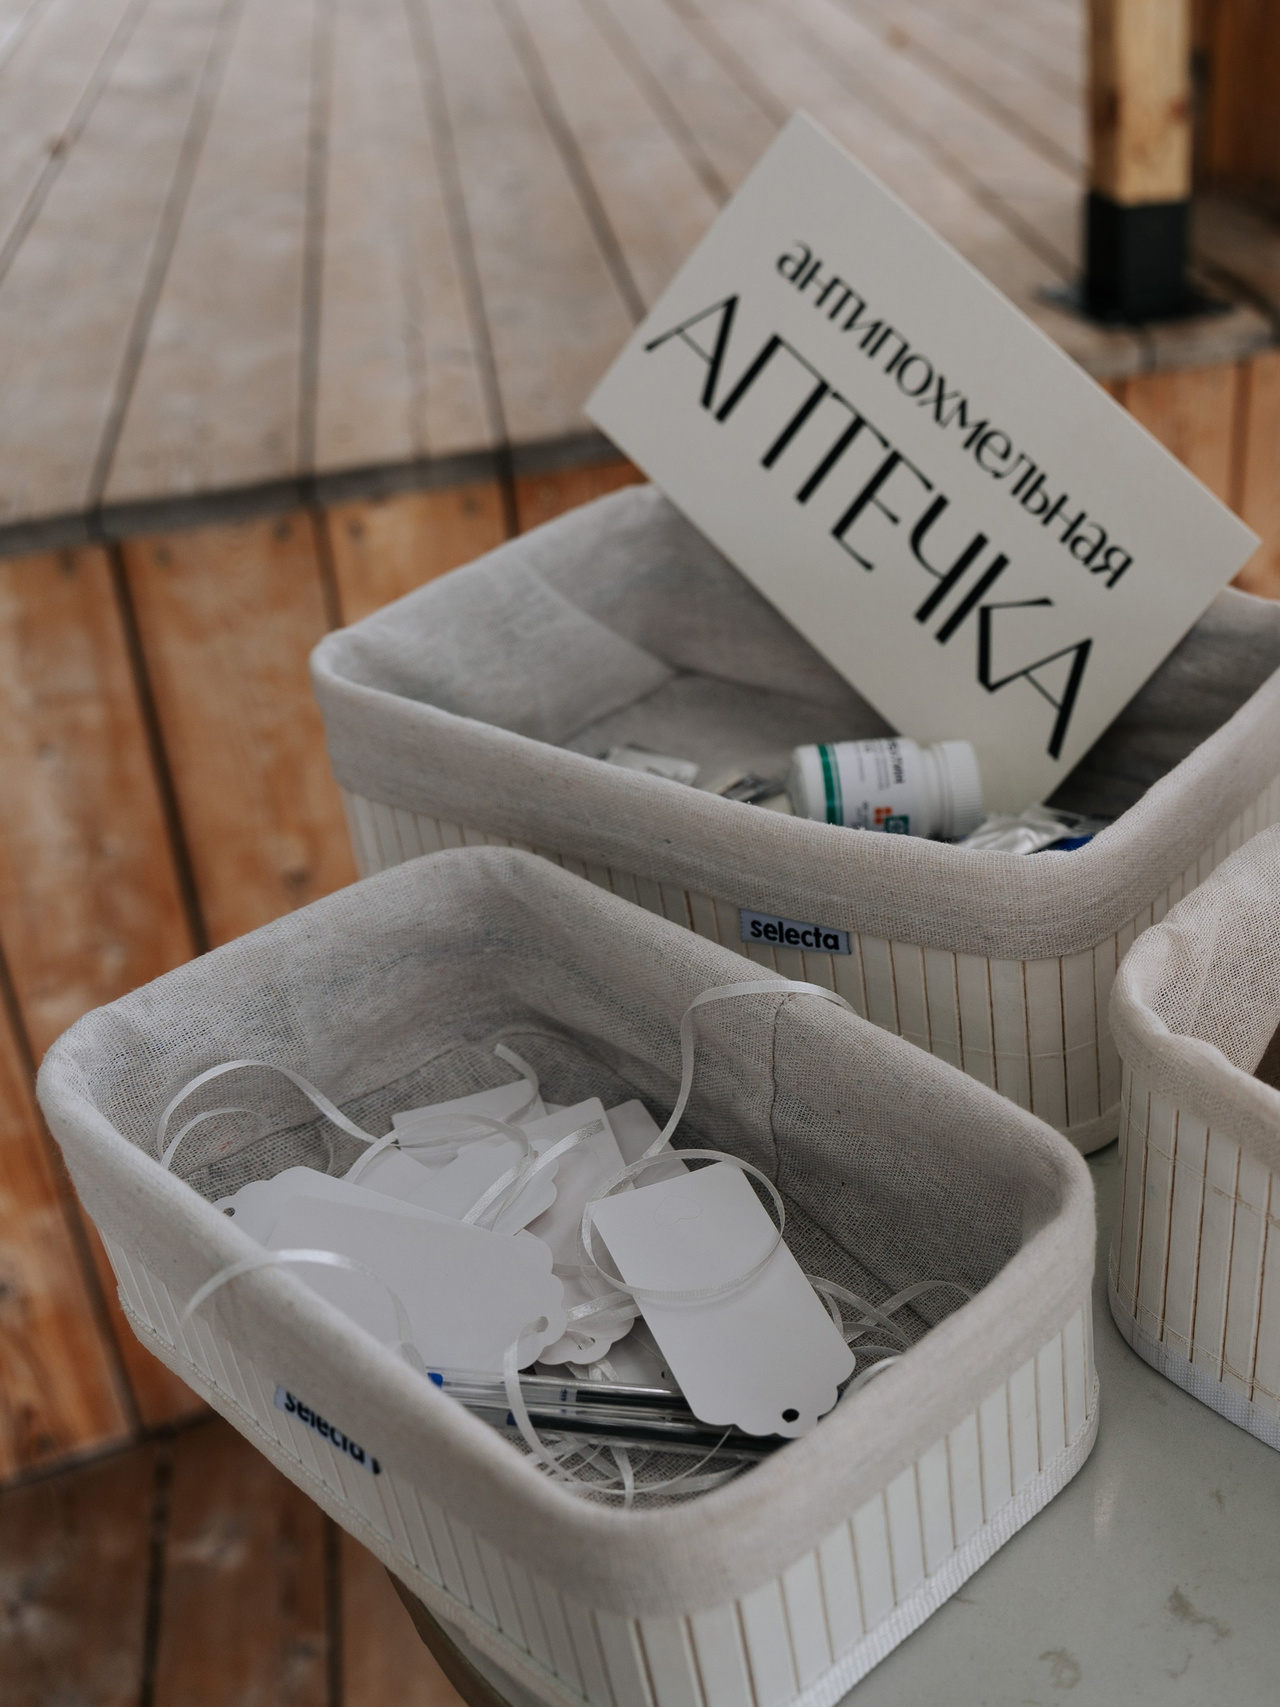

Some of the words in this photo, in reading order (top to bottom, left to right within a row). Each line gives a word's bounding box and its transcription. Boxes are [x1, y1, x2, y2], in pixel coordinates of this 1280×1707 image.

[644, 293, 1093, 761] АПТЕЧКА
[776, 240, 1134, 589] антипохмельная
[750, 919, 840, 951] selecta
